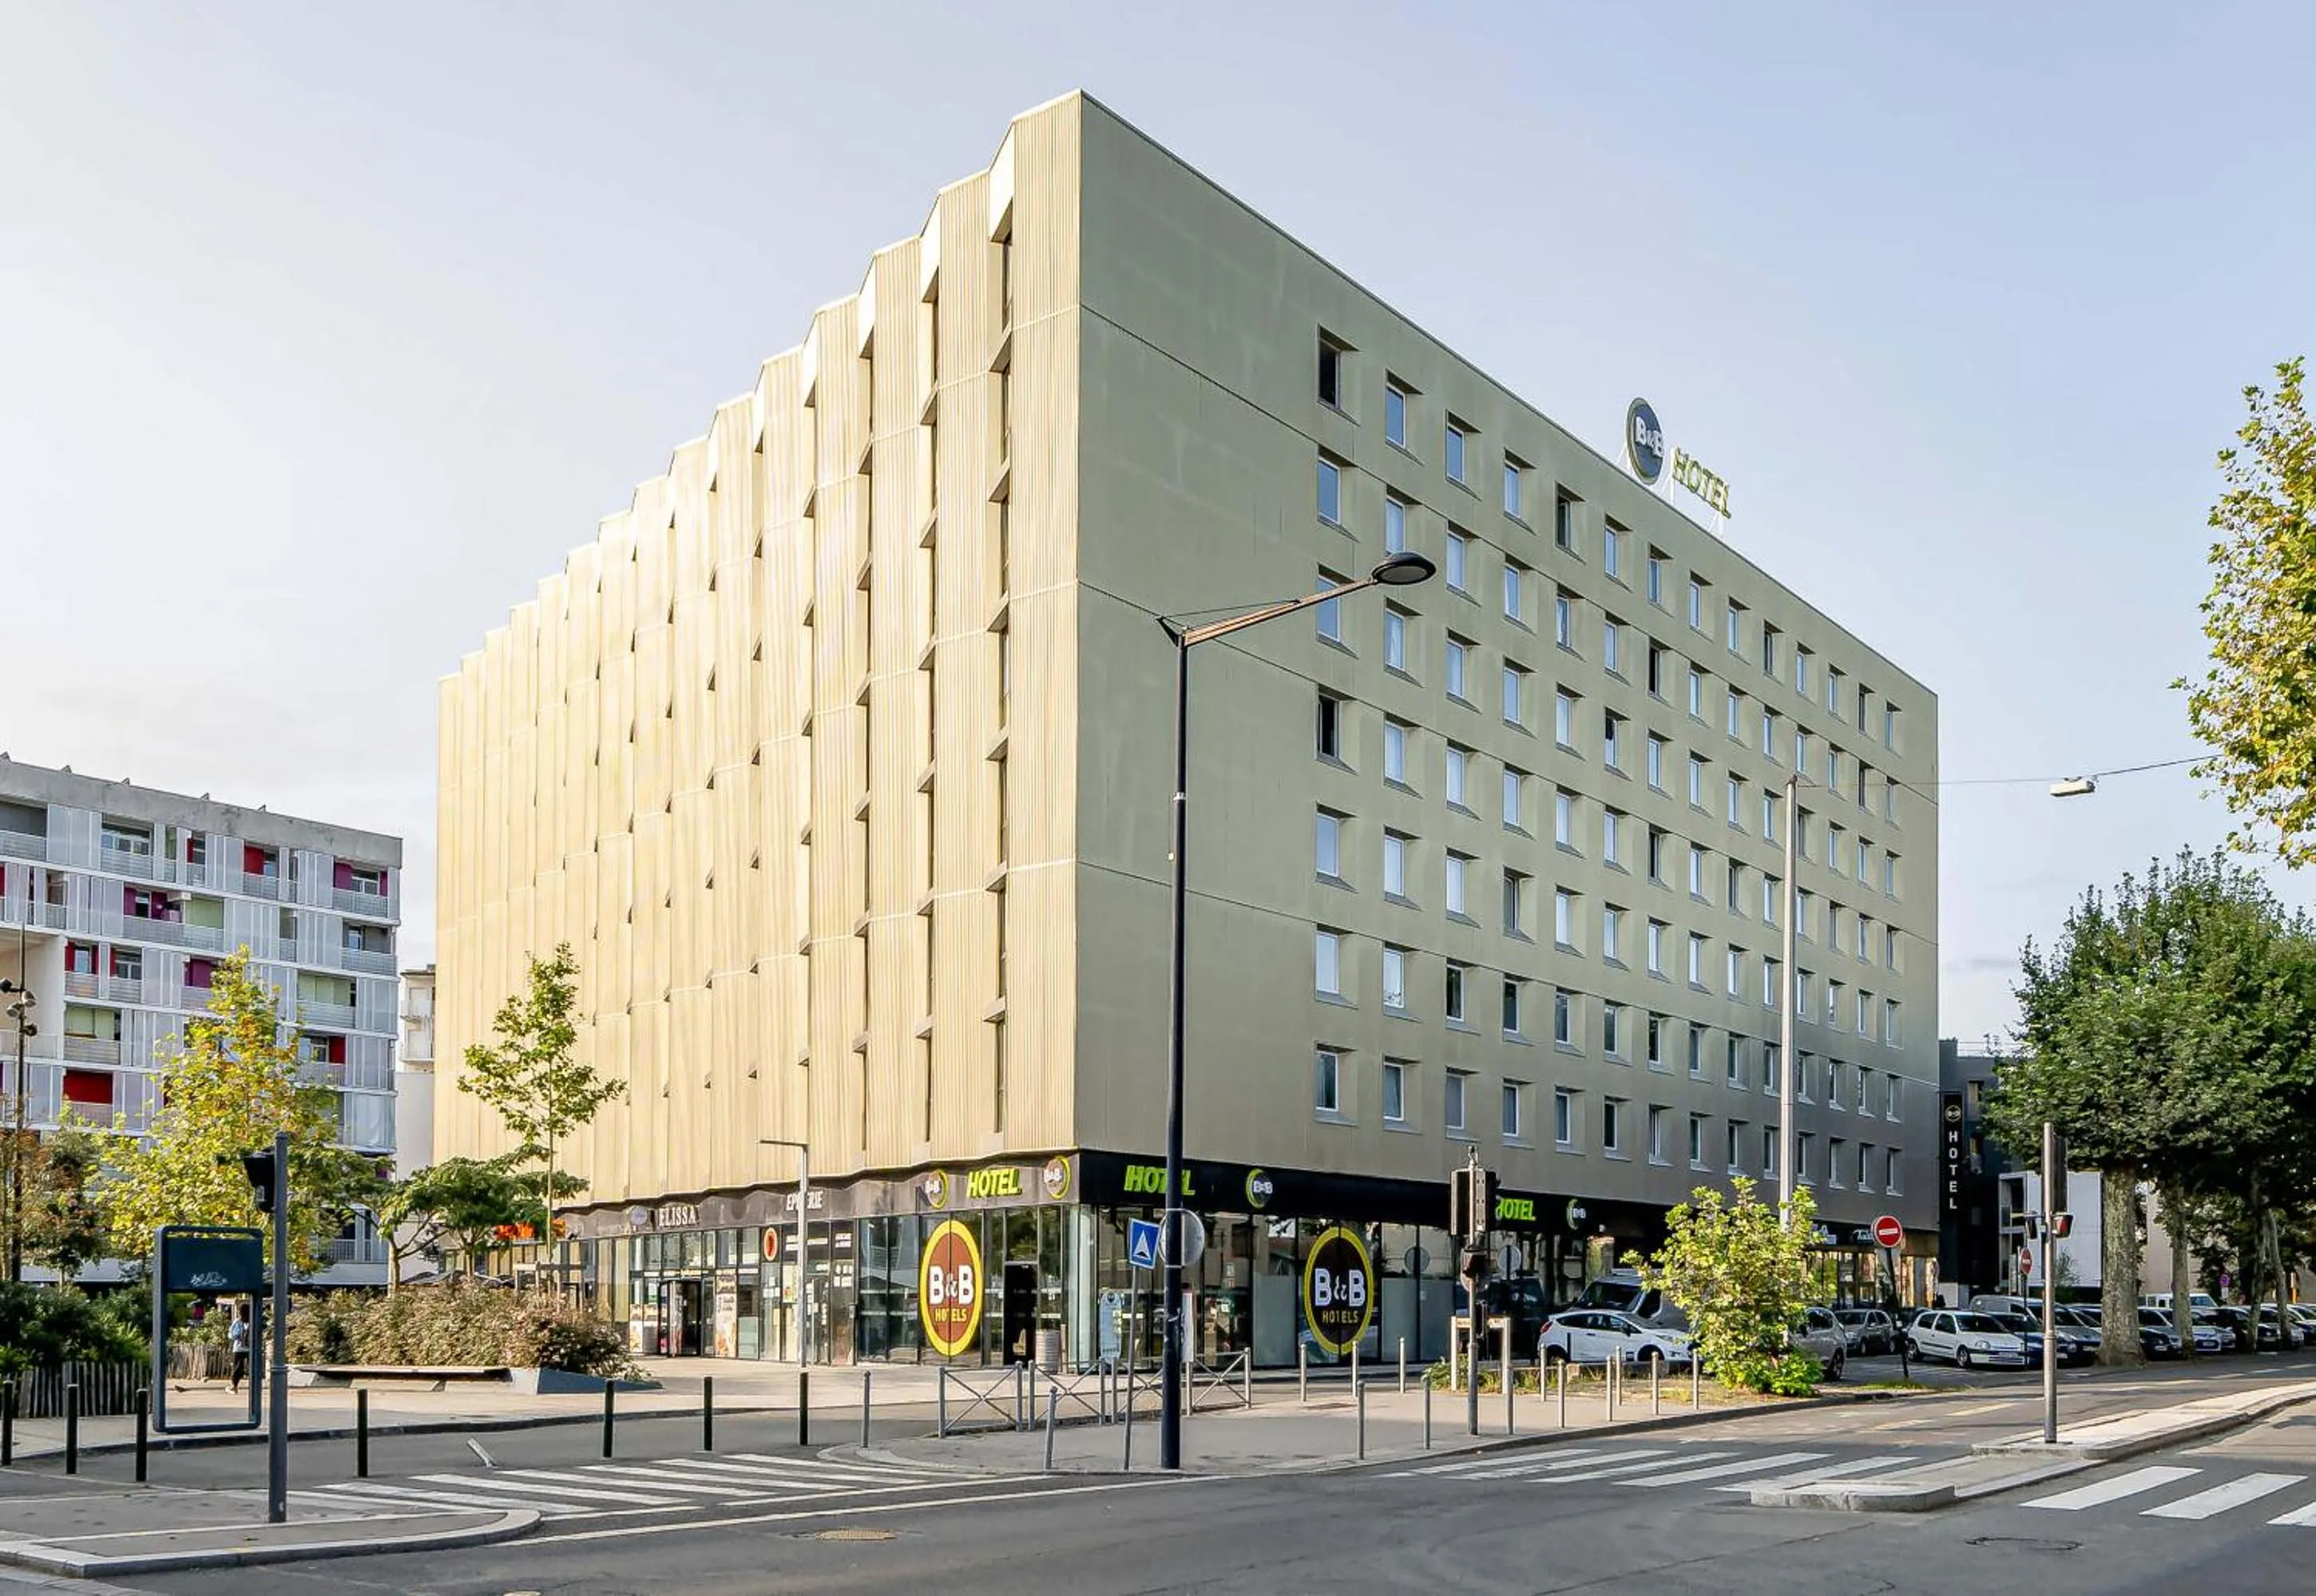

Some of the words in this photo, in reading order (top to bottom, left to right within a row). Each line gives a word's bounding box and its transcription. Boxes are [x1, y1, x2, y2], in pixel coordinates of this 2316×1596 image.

[1672, 447, 1731, 519] HOTEL
[966, 1168, 1023, 1197] HOTEL
[1124, 1165, 1196, 1196] HOTL
[1949, 1131, 1958, 1210] HOTEL
[659, 1206, 696, 1226] ELISSA
[929, 1265, 974, 1305] B&B
[1315, 1268, 1366, 1307] B&B
[1323, 1310, 1359, 1324] HOTELS
